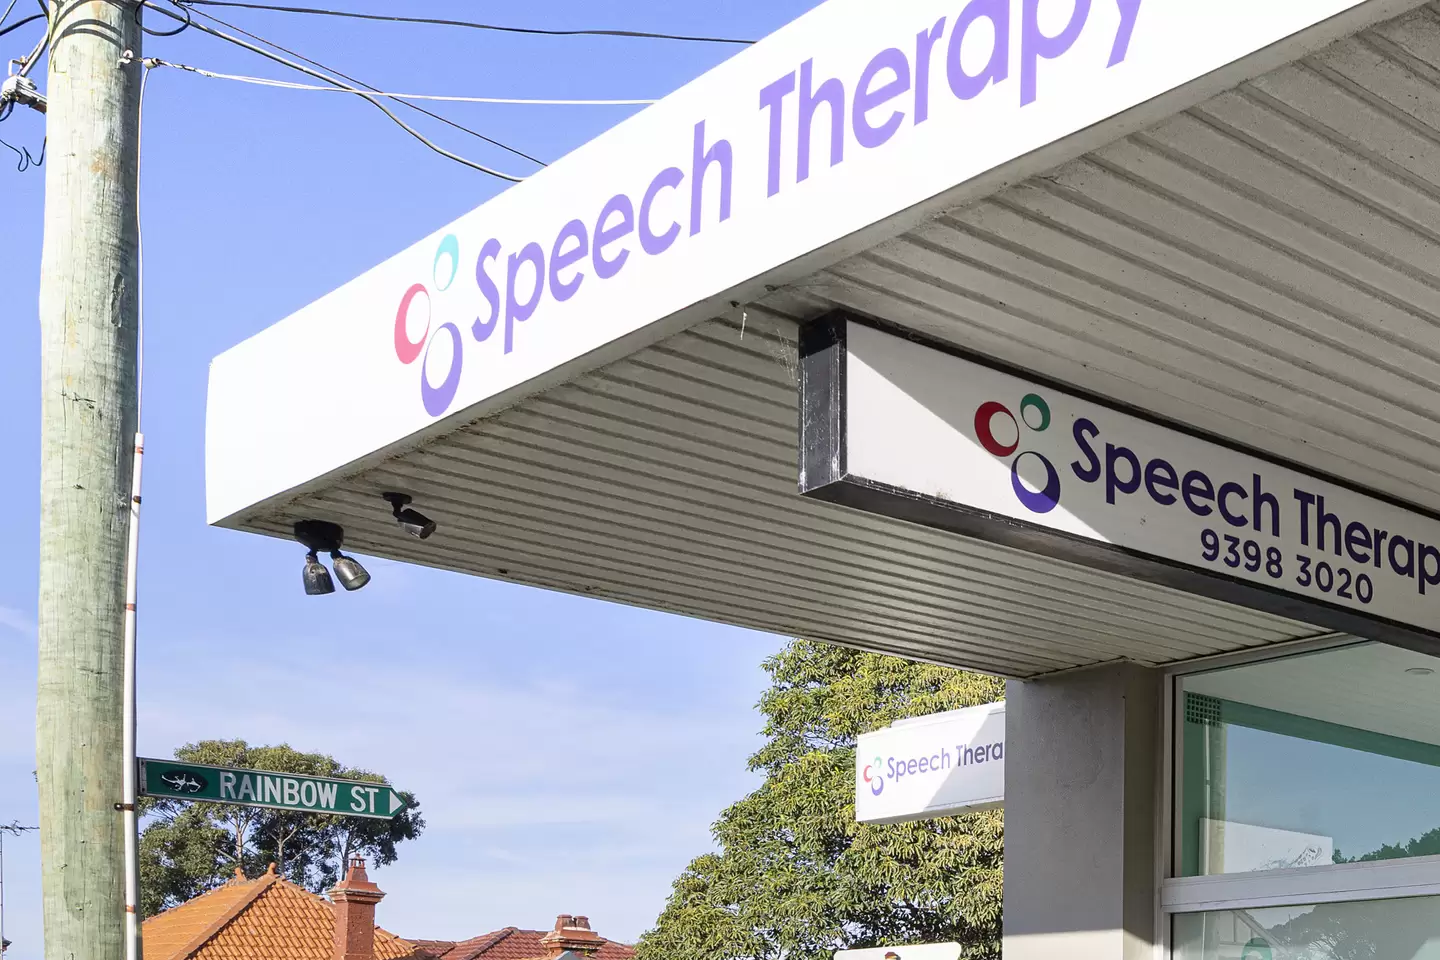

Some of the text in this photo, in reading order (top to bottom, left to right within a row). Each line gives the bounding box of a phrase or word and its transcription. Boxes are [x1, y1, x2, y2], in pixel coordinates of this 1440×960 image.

[471, 119, 733, 353] Speech
[1071, 417, 1280, 537] Speech
[1201, 528, 1373, 605] 9398 3020
[219, 771, 379, 813] RAINBOW ST
[887, 747, 950, 782] Speech
